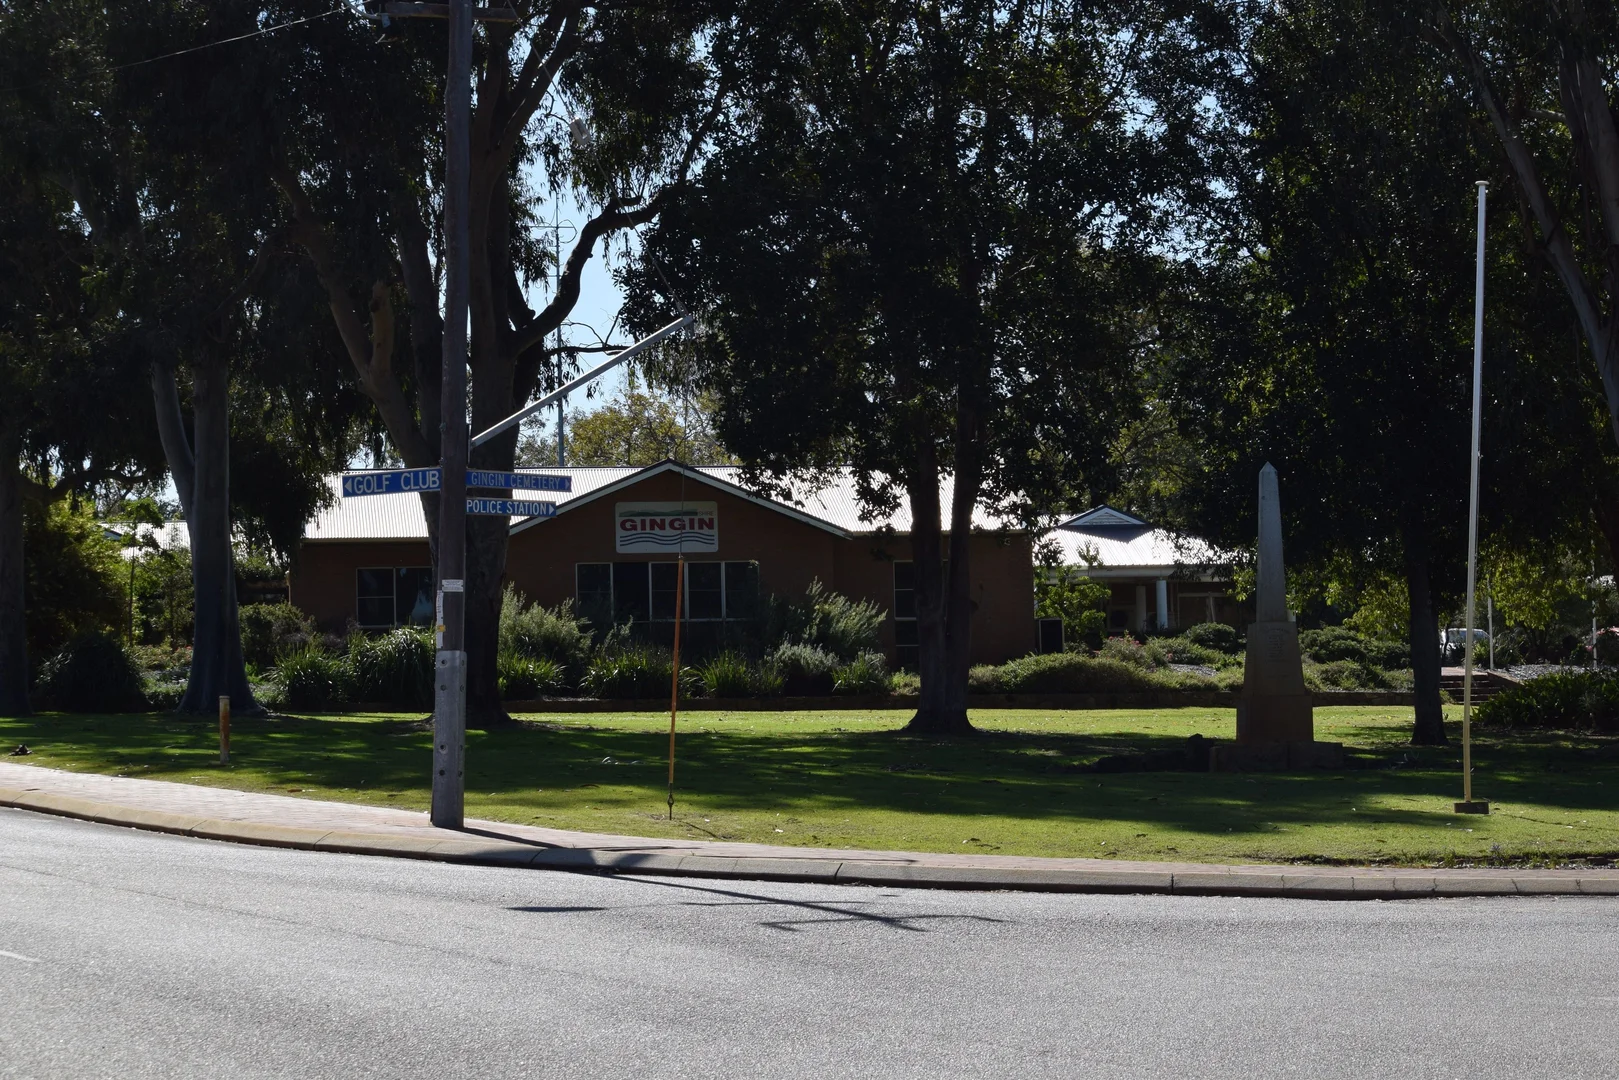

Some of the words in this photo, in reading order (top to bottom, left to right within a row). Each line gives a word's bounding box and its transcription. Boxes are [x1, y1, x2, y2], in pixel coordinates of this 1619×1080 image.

[354, 474, 390, 494] GOLF
[401, 470, 440, 491] CLUB
[471, 472, 505, 487] GINGIN
[510, 475, 561, 490] CEMETERY
[466, 500, 503, 514] POLICE
[506, 502, 546, 516] STATION
[620, 518, 714, 531] GINGIN
